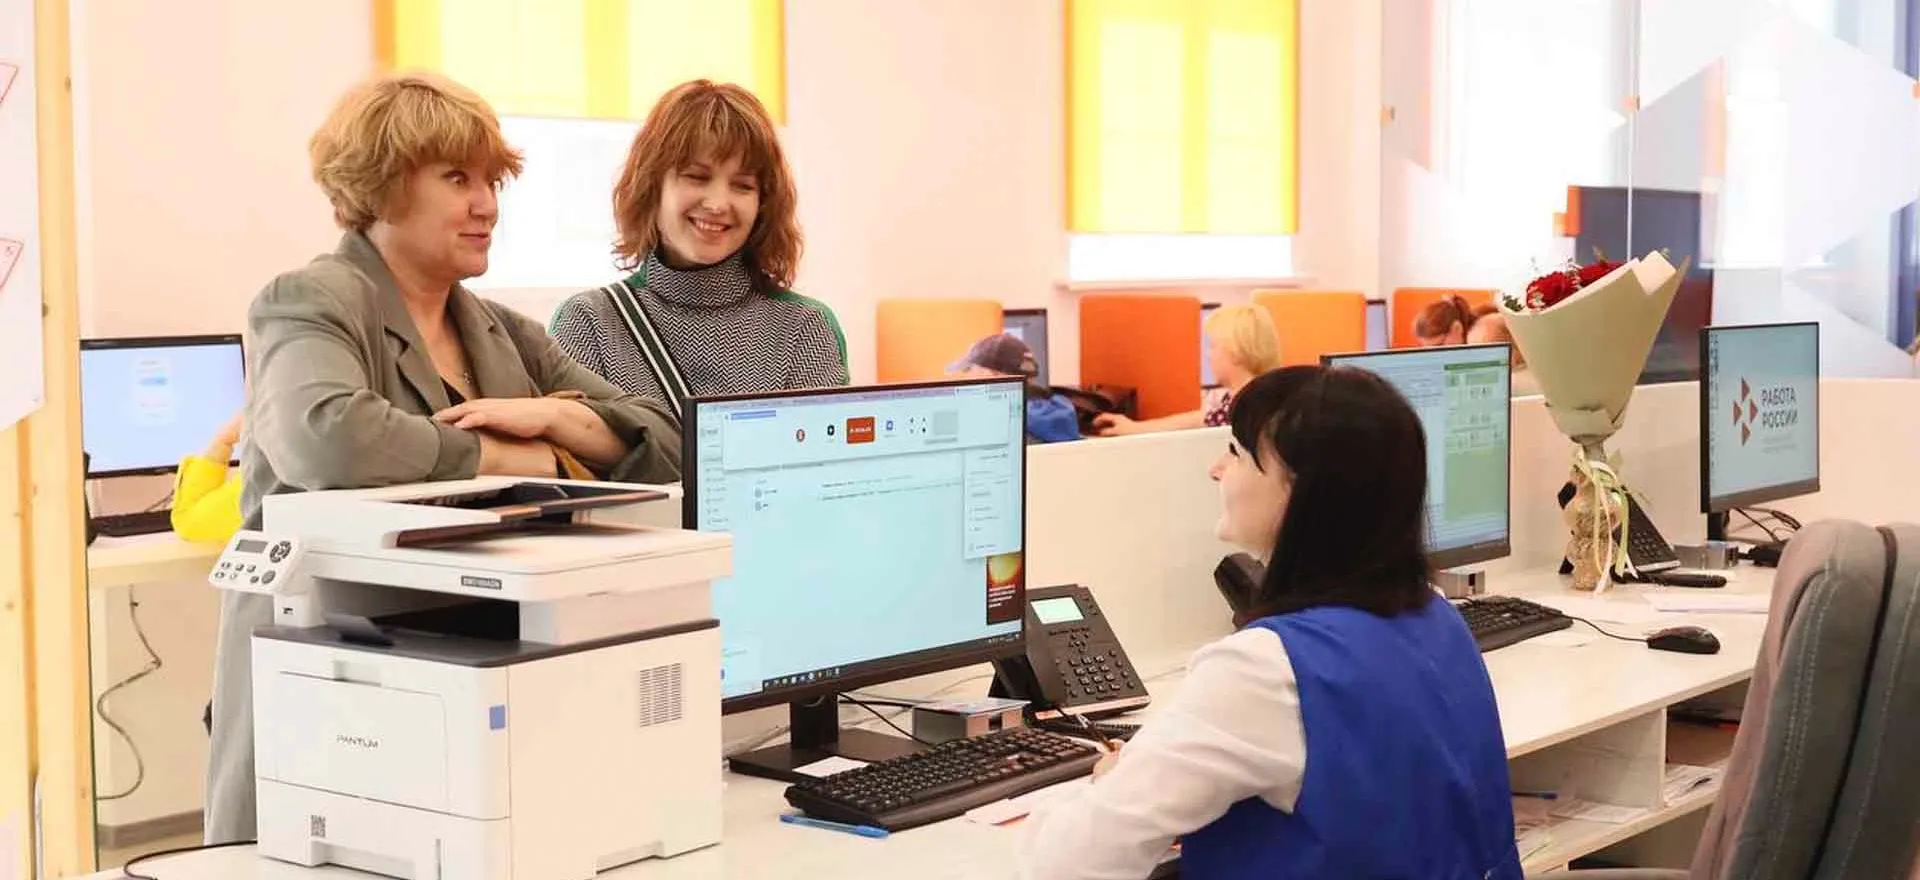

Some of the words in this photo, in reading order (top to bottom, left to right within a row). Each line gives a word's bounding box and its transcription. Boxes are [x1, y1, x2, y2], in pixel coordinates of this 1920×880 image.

[1761, 386, 1796, 406] РАБОТА
[1761, 409, 1798, 428] РОССИИ
[336, 734, 378, 748] PANTUM
